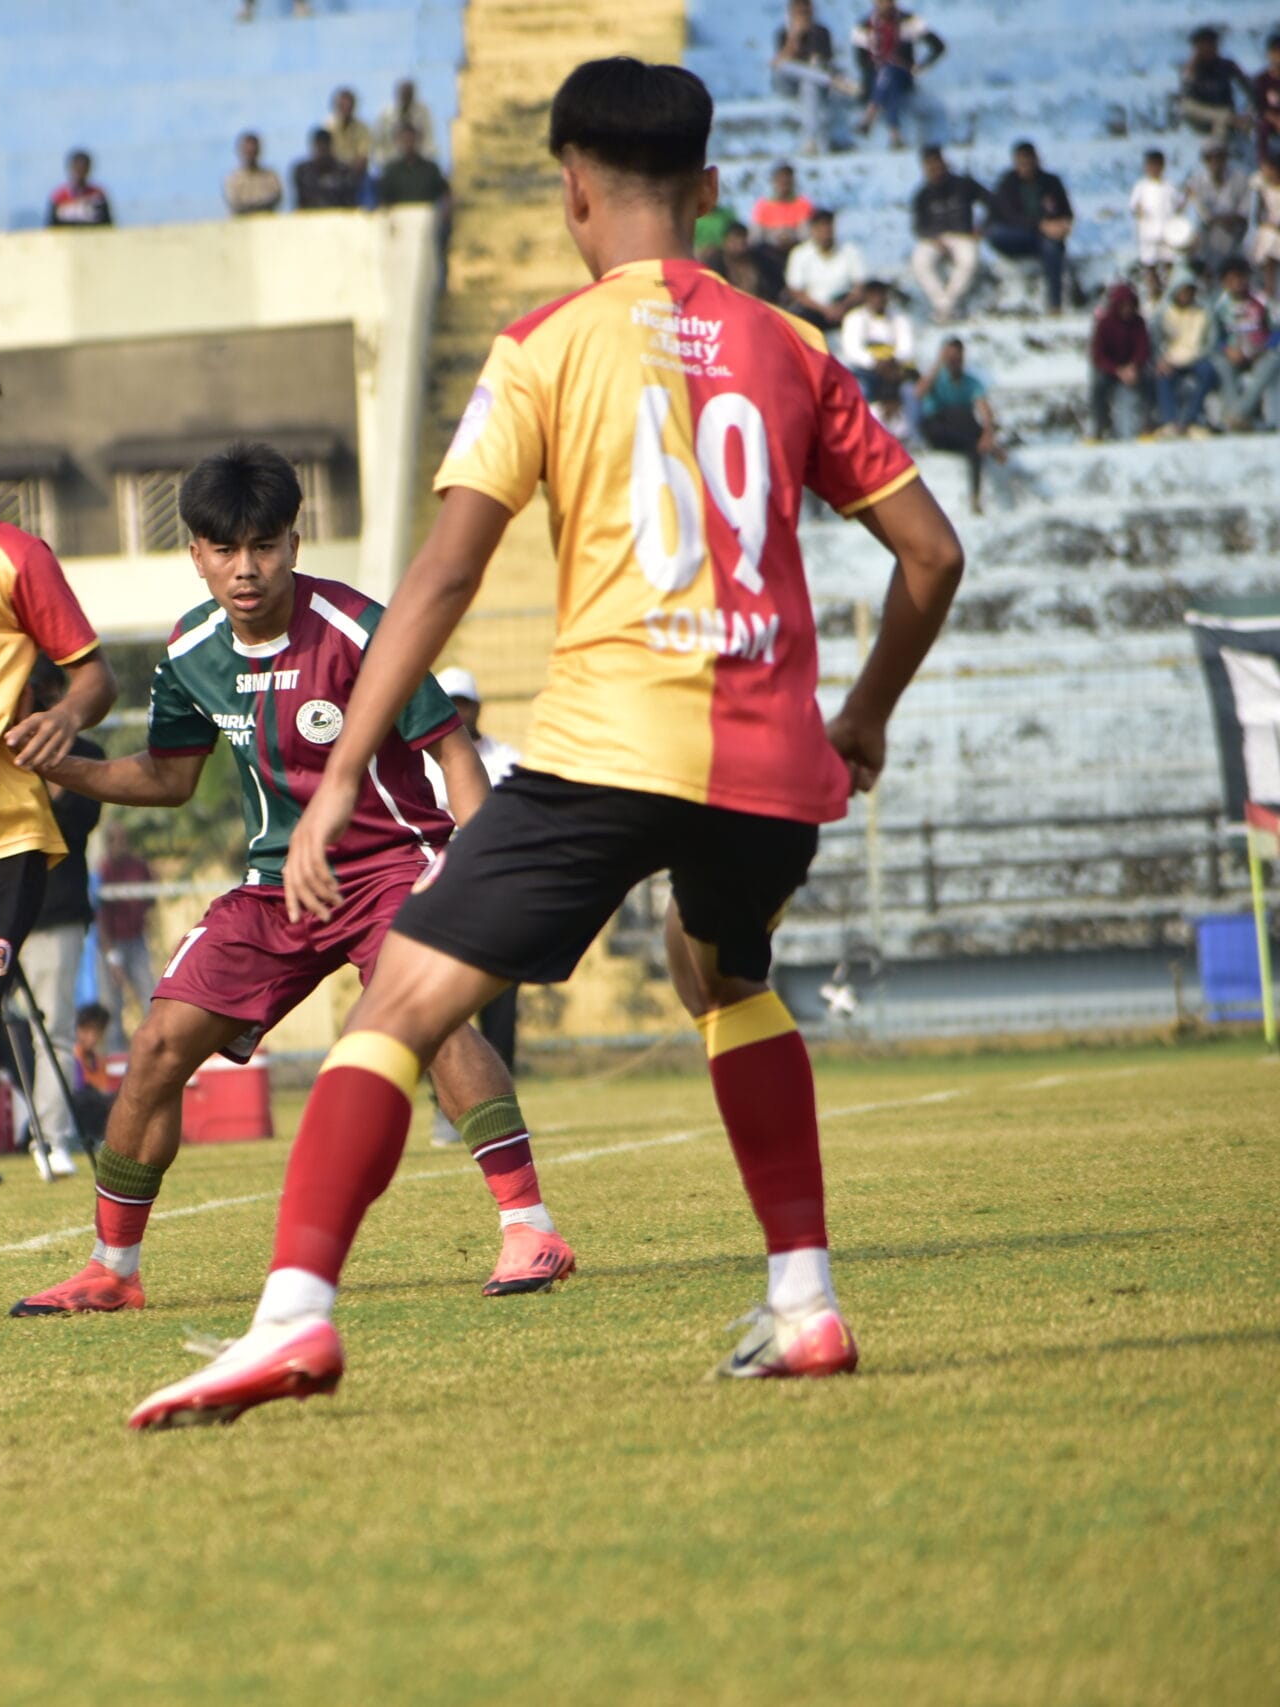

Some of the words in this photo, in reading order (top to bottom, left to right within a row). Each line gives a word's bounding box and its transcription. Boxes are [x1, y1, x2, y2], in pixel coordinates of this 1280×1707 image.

[631, 306, 723, 342] Healthy
[630, 384, 772, 596] 69
[644, 608, 779, 664] SONAM
